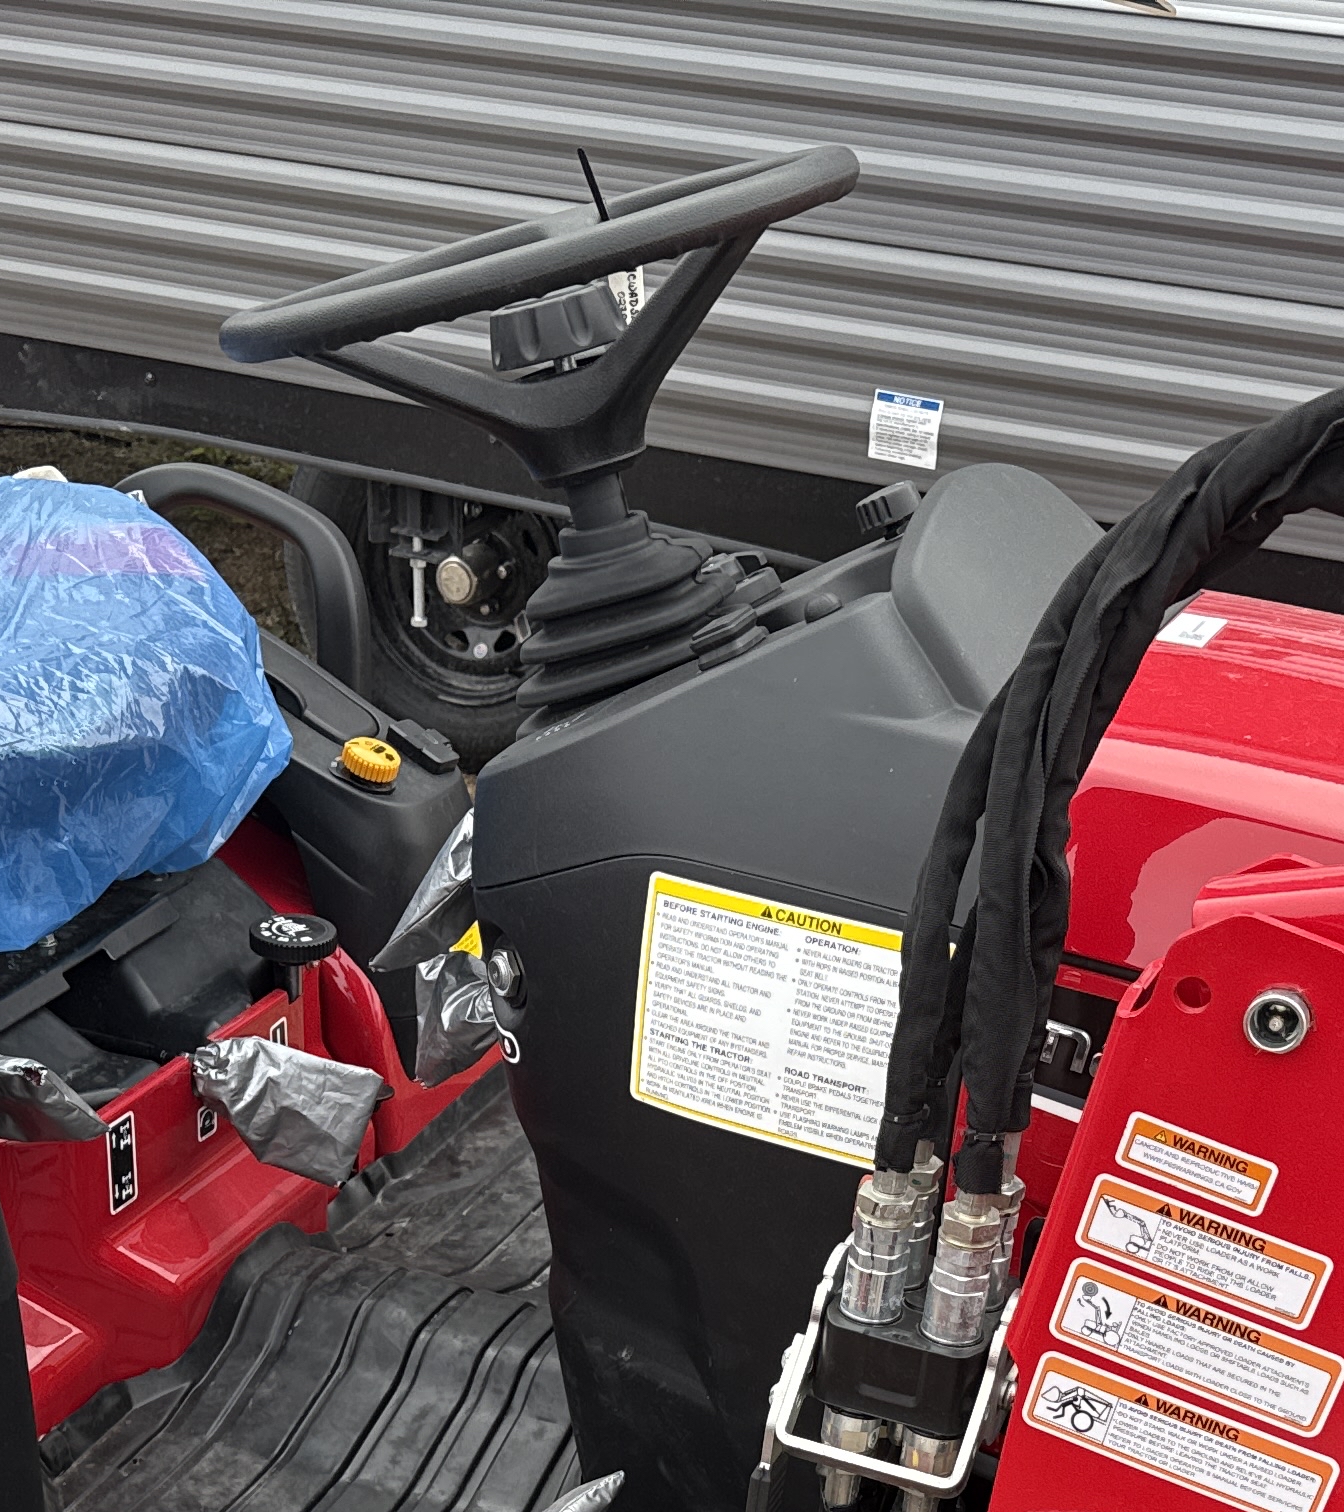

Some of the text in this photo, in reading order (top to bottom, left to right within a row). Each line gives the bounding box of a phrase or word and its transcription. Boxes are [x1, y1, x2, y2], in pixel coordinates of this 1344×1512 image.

[893, 395, 922, 408] NOTICE
[662, 899, 698, 916] BEFORE
[699, 908, 744, 927] STARTING
[776, 909, 842, 935] CAUTION
[649, 1027, 689, 1046] STARTING
[690, 1039, 707, 1052] THE
[783, 1064, 810, 1080] ROAD
[1173, 1134, 1248, 1174] WARNING
[1160, 1218, 1173, 1228] TO
[1259, 1256, 1284, 1270] FROM
[1160, 1228, 1188, 1243] NEVER
[1204, 1244, 1238, 1262] LOADER
[1236, 1257, 1249, 1266] AS
[1247, 1261, 1256, 1269] A
[1178, 1207, 1266, 1253] WARNING
[1150, 1255, 1164, 1265] OR
[1155, 1242, 1169, 1252] DO
[1167, 1247, 1186, 1259] NOT
[1209, 1263, 1235, 1277] FROM
[1233, 1272, 1247, 1282] OR
[1246, 1277, 1275, 1293] ALLOW
[1184, 1261, 1196, 1270] TO
[1244, 1283, 1277, 1301] LOADER
[1175, 1300, 1262, 1345] WARNING
[1155, 1398, 1240, 1443] WARNING
